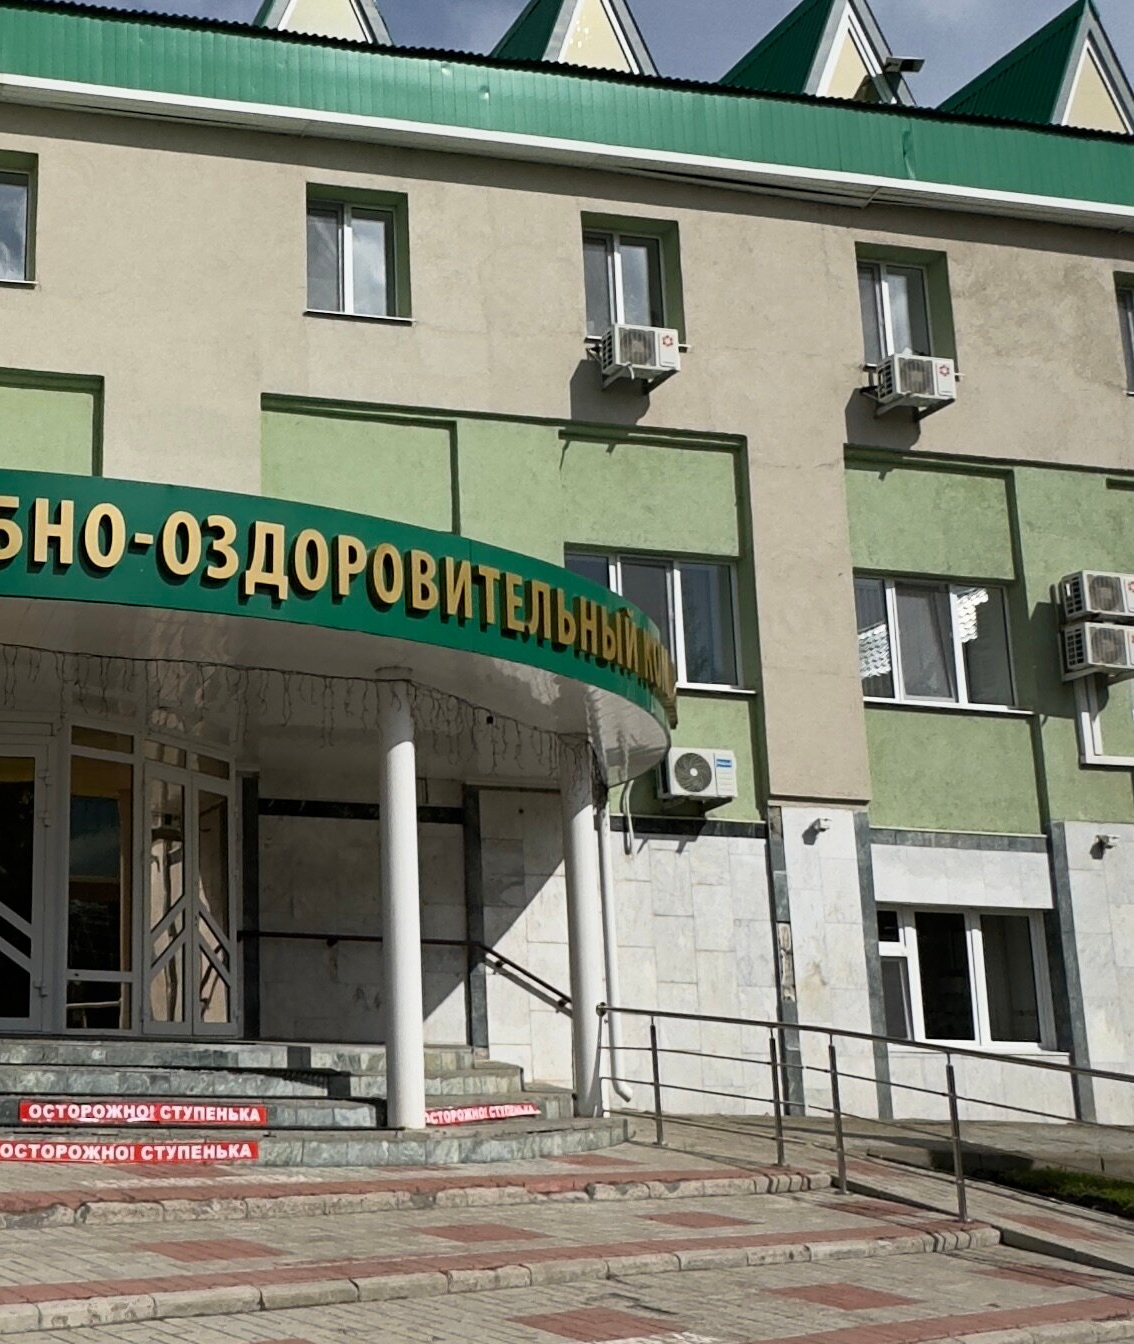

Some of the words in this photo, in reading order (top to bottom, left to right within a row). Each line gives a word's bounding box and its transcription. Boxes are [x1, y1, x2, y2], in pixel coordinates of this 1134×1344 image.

[28, 1104, 155, 1120] ОСТОРОЖНО!
[159, 1105, 261, 1122] СТУПЕНЬКА
[0, 1143, 135, 1160] ОСТОРОЖНО!
[141, 1143, 252, 1160] СТУПЕНЬКА
